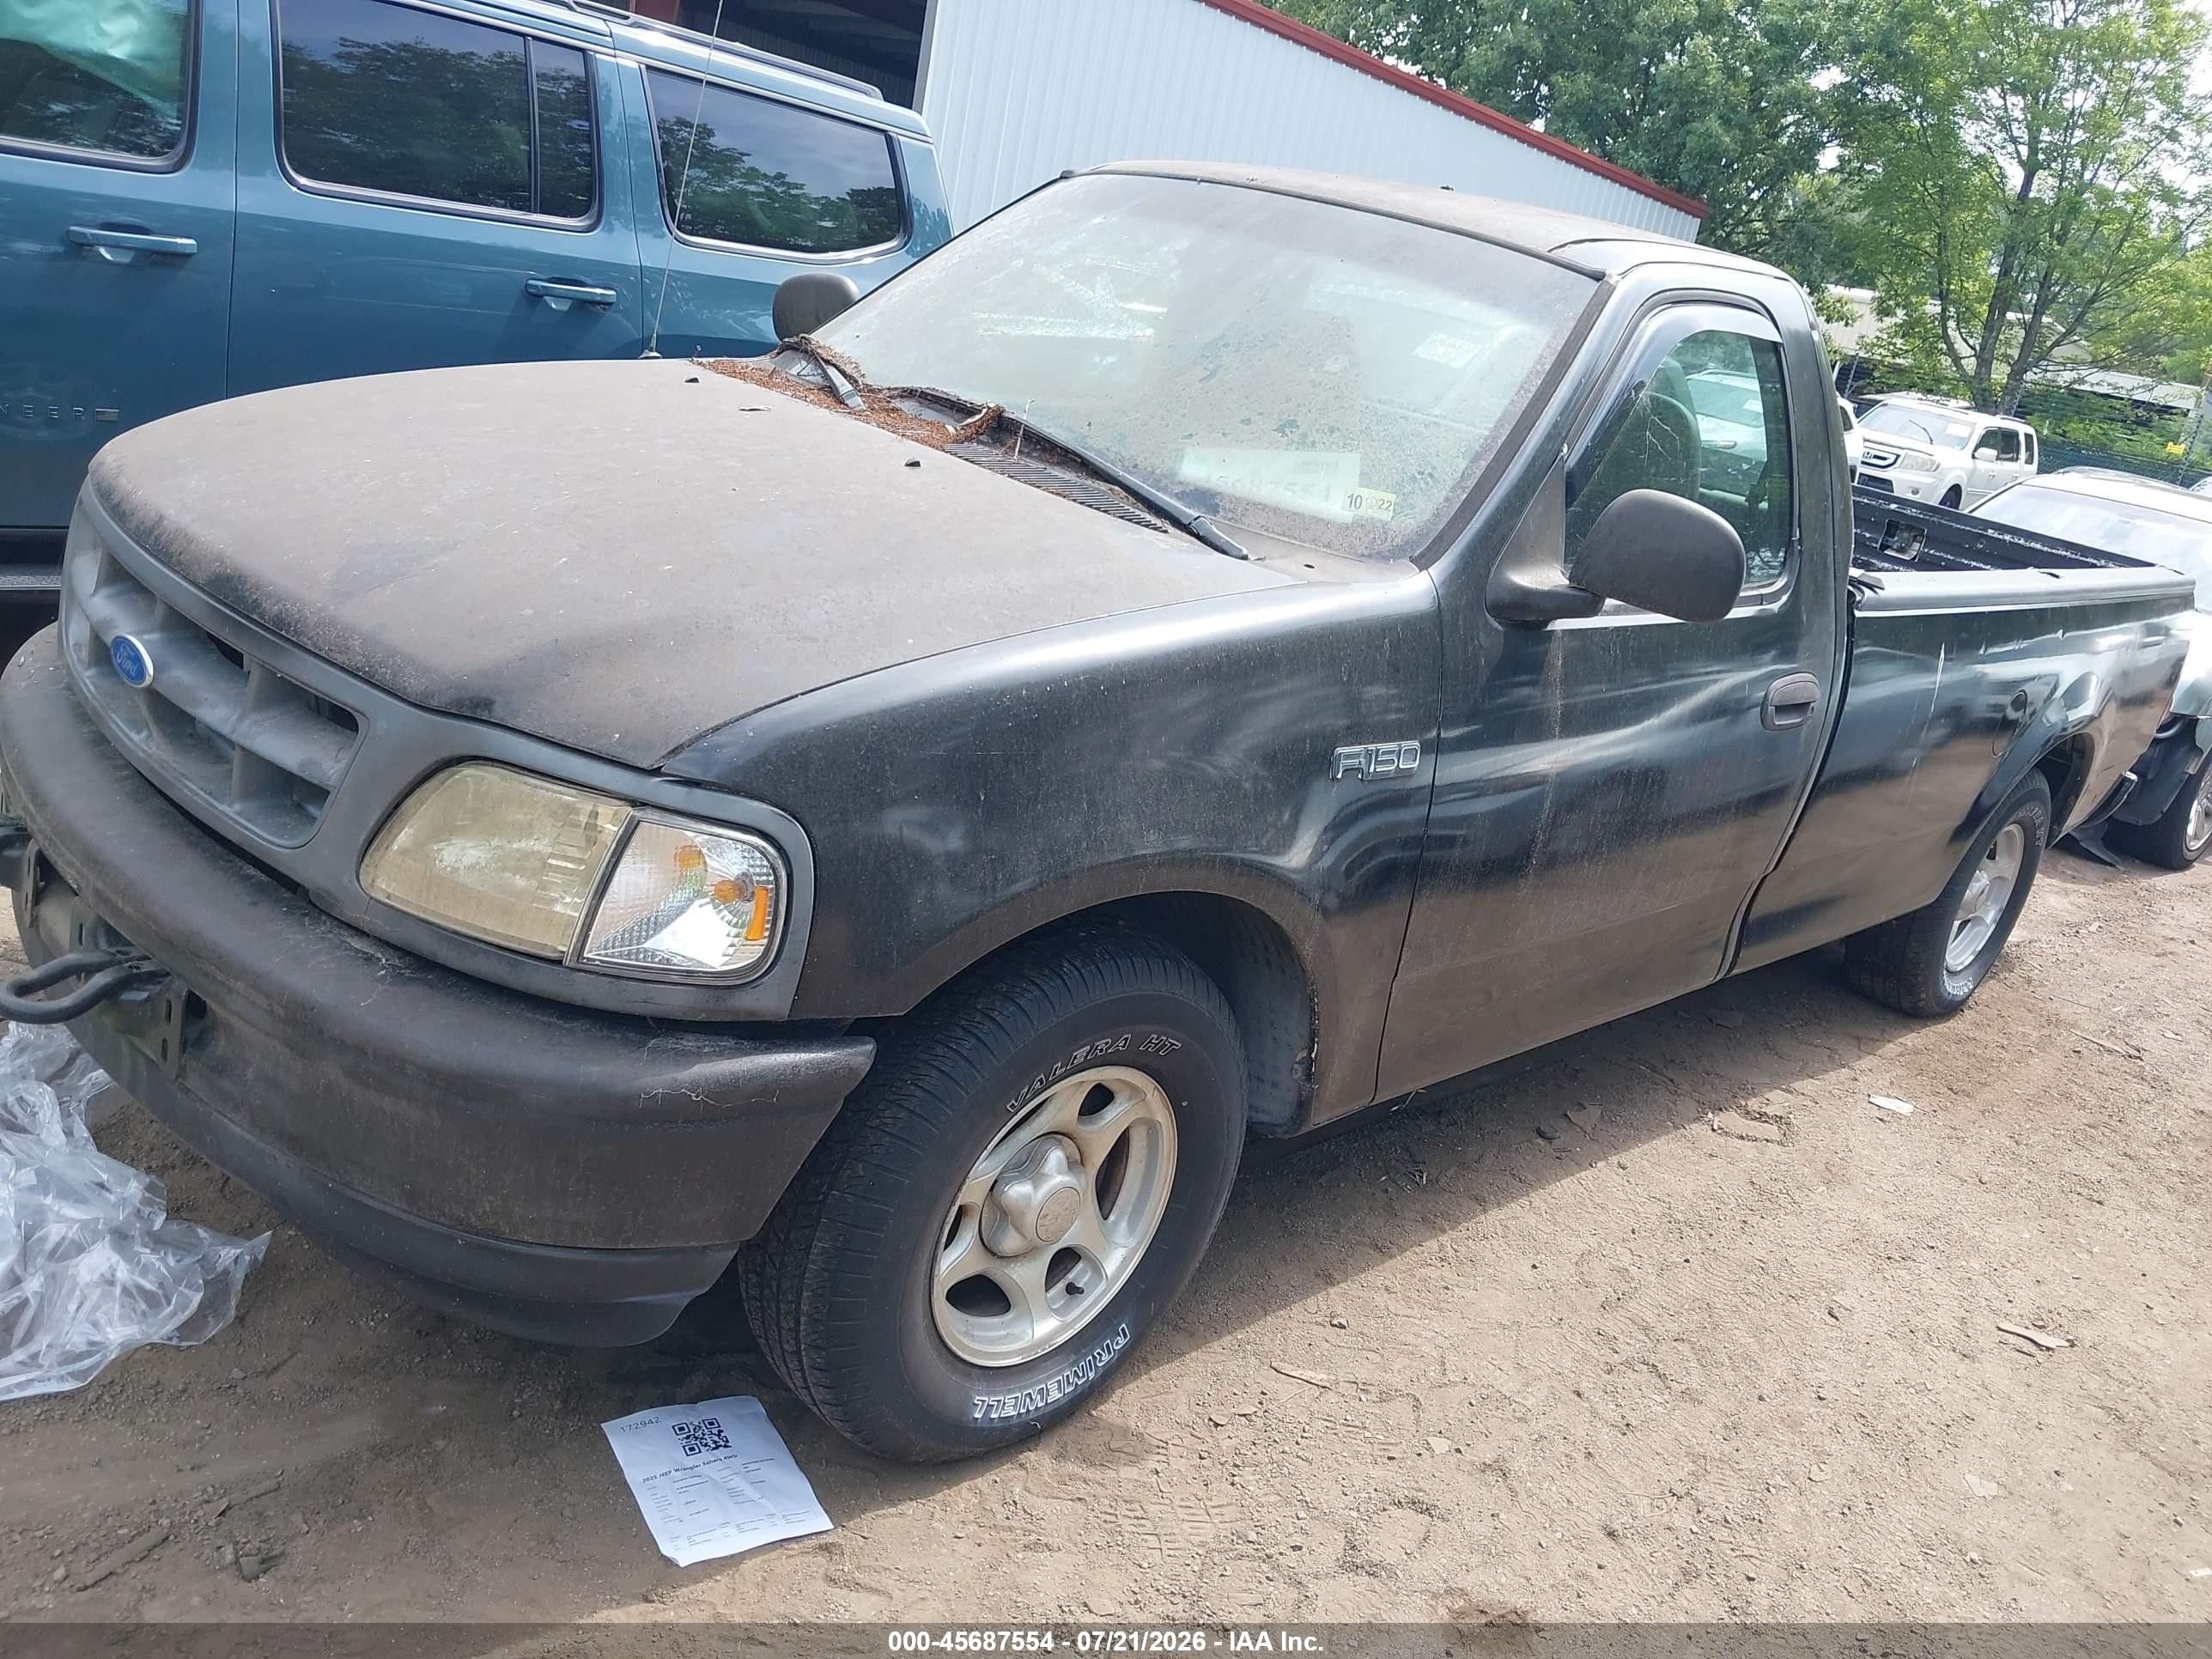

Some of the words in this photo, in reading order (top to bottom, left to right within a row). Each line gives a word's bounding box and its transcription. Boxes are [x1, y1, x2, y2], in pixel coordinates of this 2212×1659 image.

[1347, 493, 1363, 509] 10
[1377, 498, 1393, 513] 22
[1006, 1033, 1132, 1113] VALERA
[1139, 1034, 1182, 1056] HT
[973, 1322, 1131, 1419] PRIMEWELL
[619, 1417, 661, 1433] 172942
[642, 1474, 658, 1484] 2025
[659, 1469, 672, 1479] JEEP
[672, 1462, 702, 1474] Wrangler
[702, 1457, 724, 1467] Sahara
